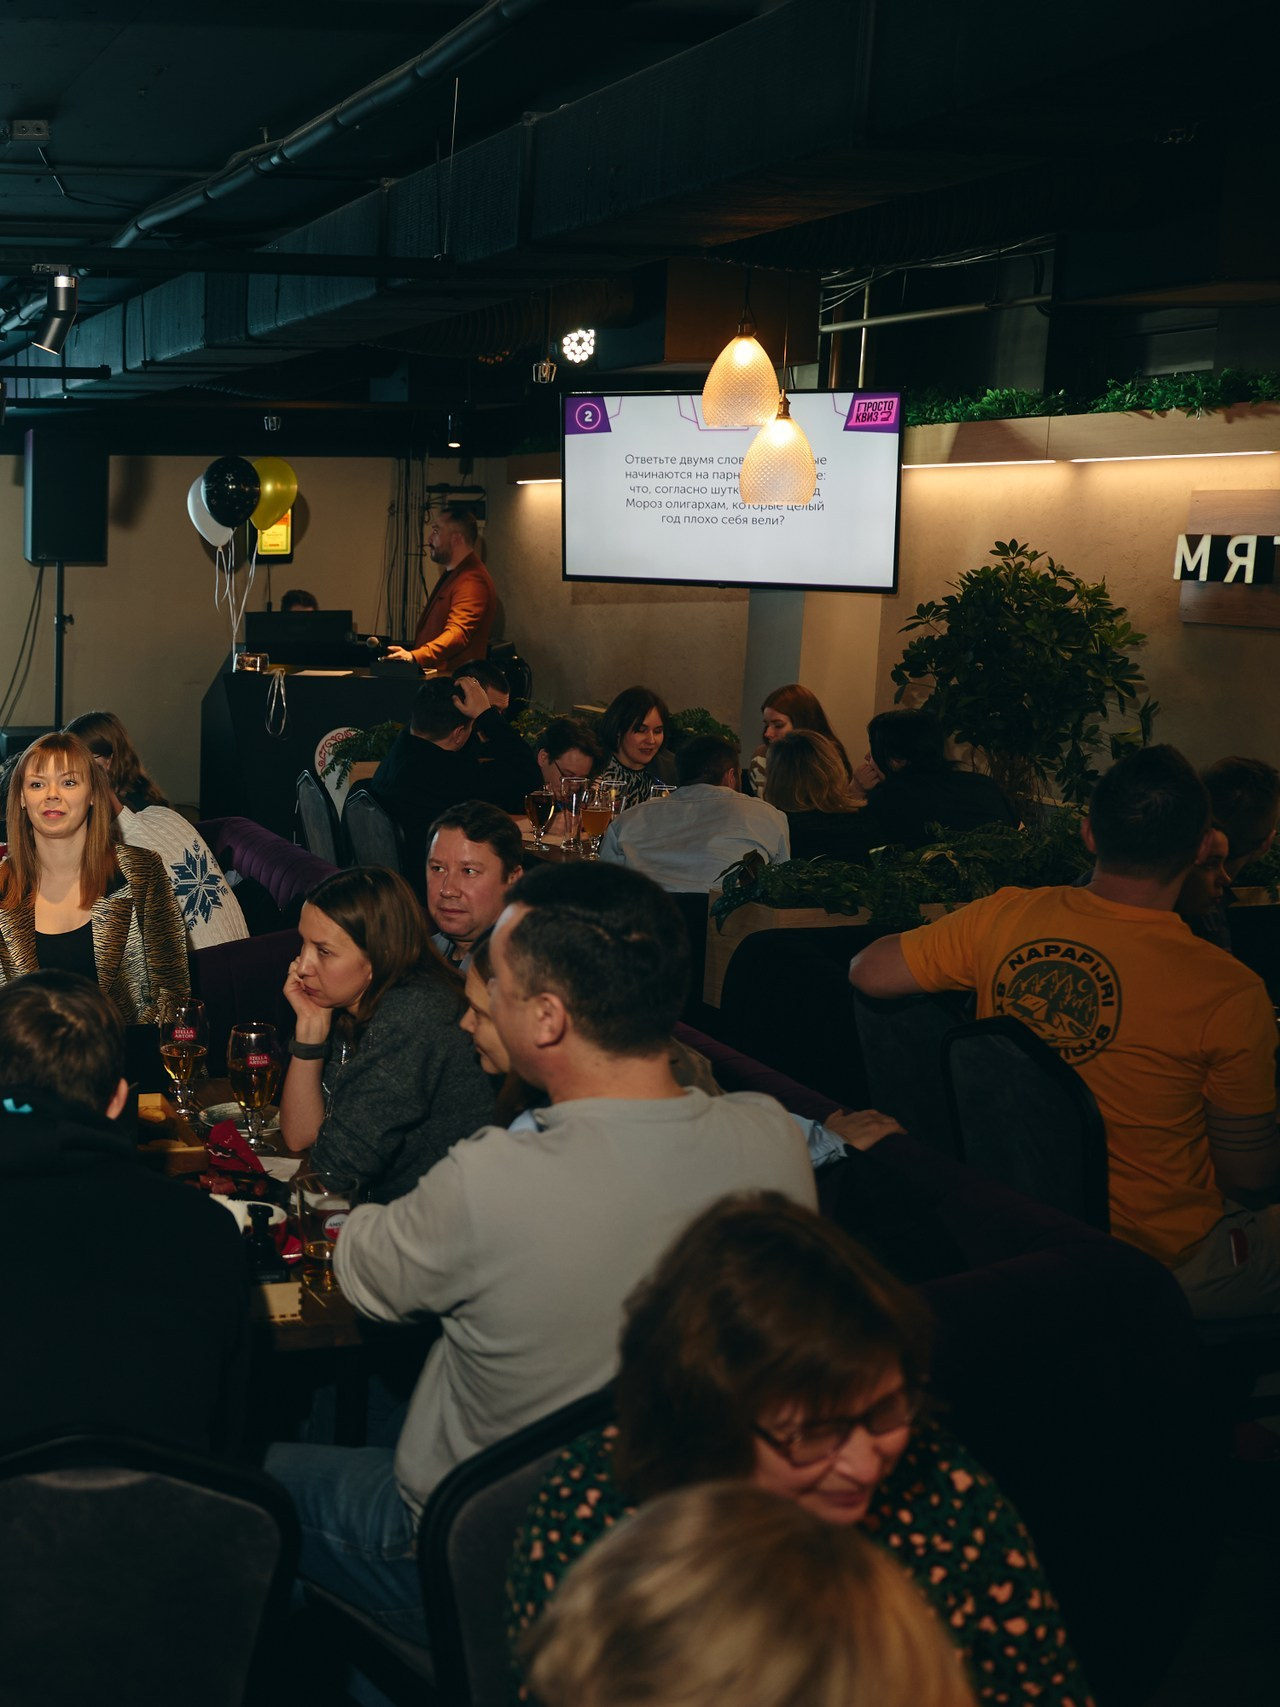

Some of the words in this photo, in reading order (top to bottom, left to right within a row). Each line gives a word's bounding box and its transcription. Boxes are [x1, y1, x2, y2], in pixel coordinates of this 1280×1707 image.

[856, 400, 894, 412] ПРОСТО
[584, 410, 593, 422] 2
[624, 454, 677, 465] Ответьте
[679, 456, 714, 467] двумя
[717, 456, 744, 465] слов
[625, 471, 692, 479] начинаются
[695, 471, 709, 479] на
[712, 472, 740, 481] парн
[629, 485, 651, 495] что,
[655, 485, 708, 495] согласно
[711, 486, 740, 497] шутк
[625, 498, 663, 510] Мороз
[661, 515, 681, 524] год
[683, 515, 718, 524] плохо
[721, 515, 748, 525] себя
[751, 515, 785, 525] вели?
[1008, 945, 1115, 1007] NAPAPIJRI
